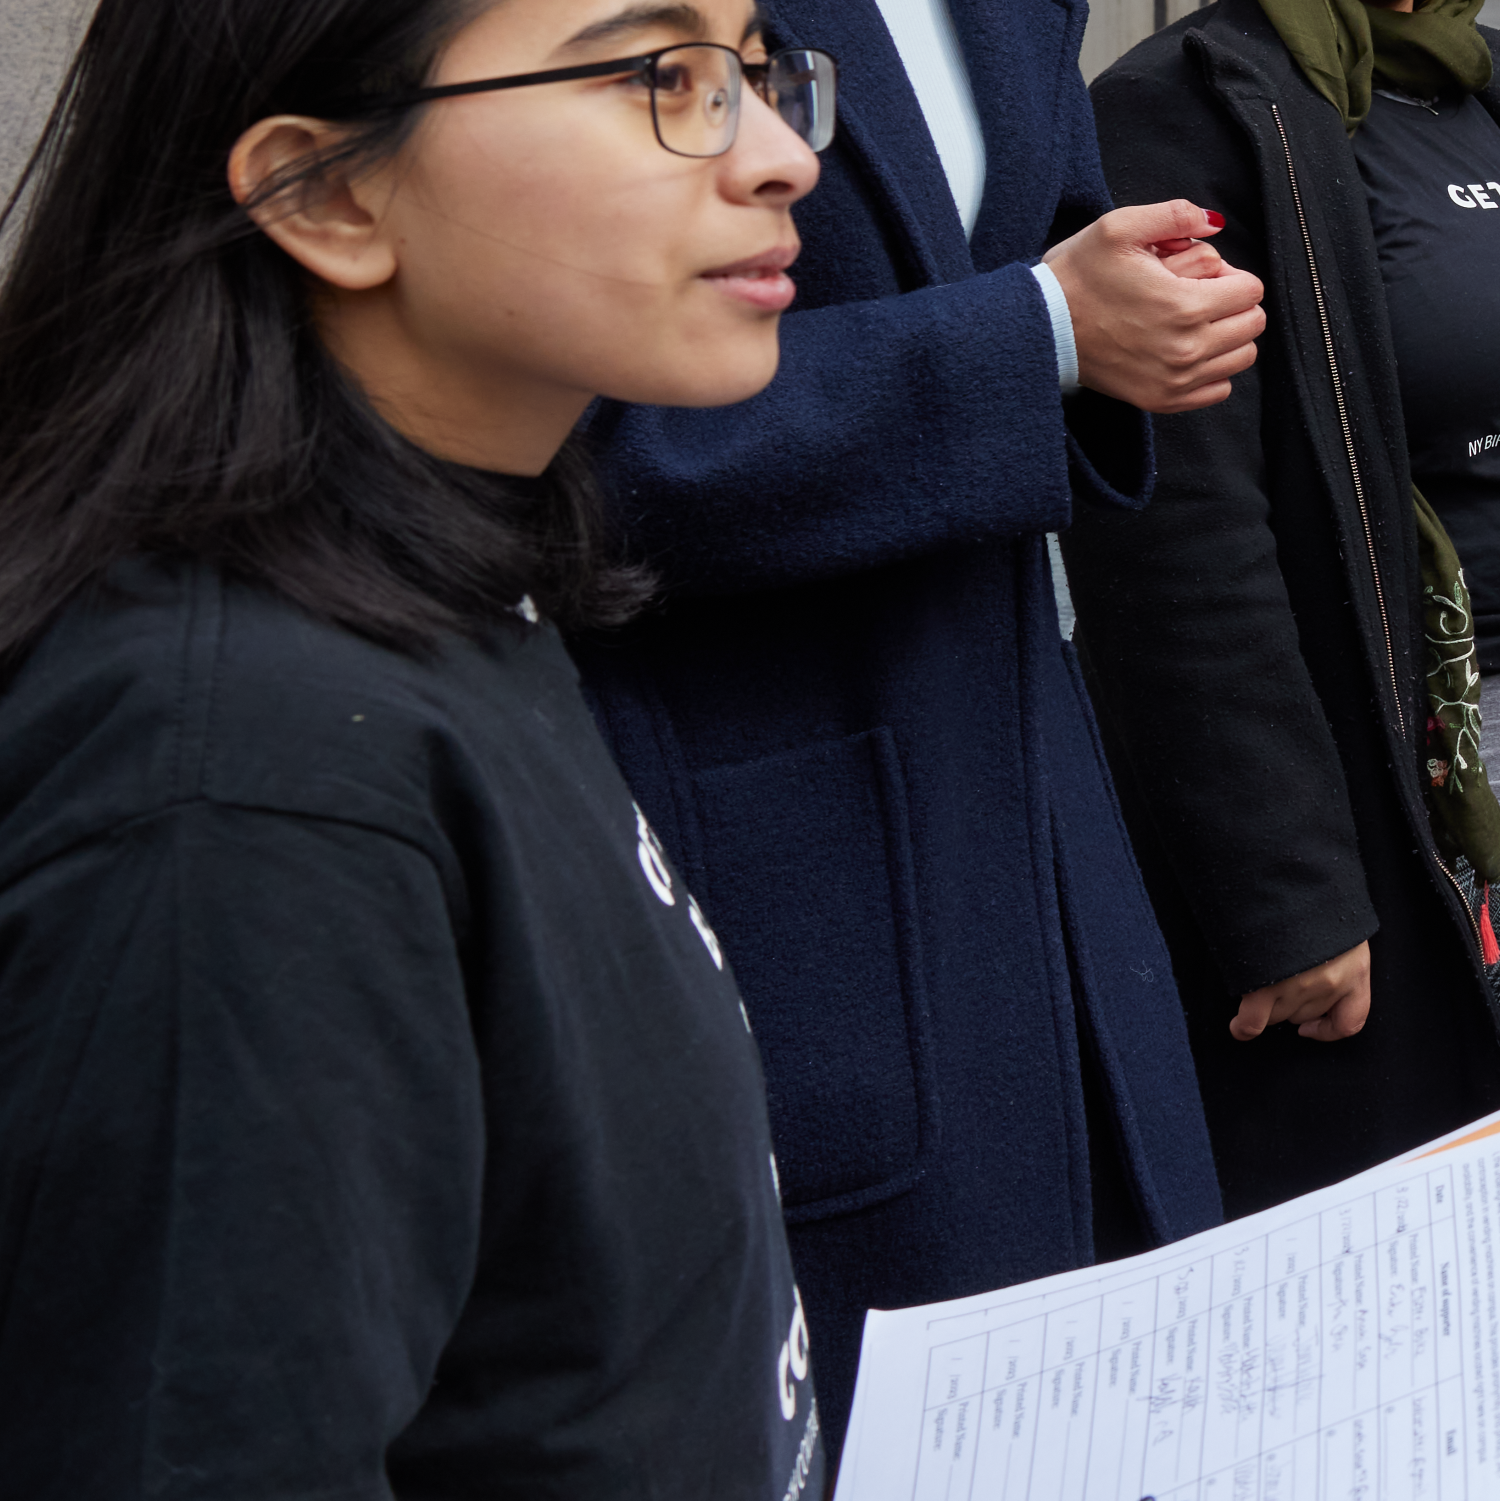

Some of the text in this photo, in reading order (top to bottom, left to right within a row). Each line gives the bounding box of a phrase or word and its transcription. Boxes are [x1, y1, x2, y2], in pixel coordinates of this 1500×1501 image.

[1468, 437, 1483, 457] NY
[1435, 1184, 1444, 1204] Date
[1354, 1253, 1363, 1280] Printed
[1409, 1233, 1419, 1285] Printed Name:
[1439, 1261, 1450, 1287] Name
[1298, 1274, 1307, 1328] Printed Name:
[1355, 1280, 1363, 1306] Name:
[1441, 1286, 1451, 1298] of
[1242, 1295, 1252, 1325] Printed
[1439, 1297, 1451, 1339] supporter
[1186, 1319, 1197, 1349] Printed
[1242, 1324, 1251, 1350] Name:
[1127, 1340, 1140, 1397] Printed Name:
[1185, 1347, 1195, 1373] Name:
[1069, 1360, 1084, 1418] Printed Name:
[1011, 1381, 1027, 1440] Printed Name:
[951, 1400, 968, 1462] Printed Name:
